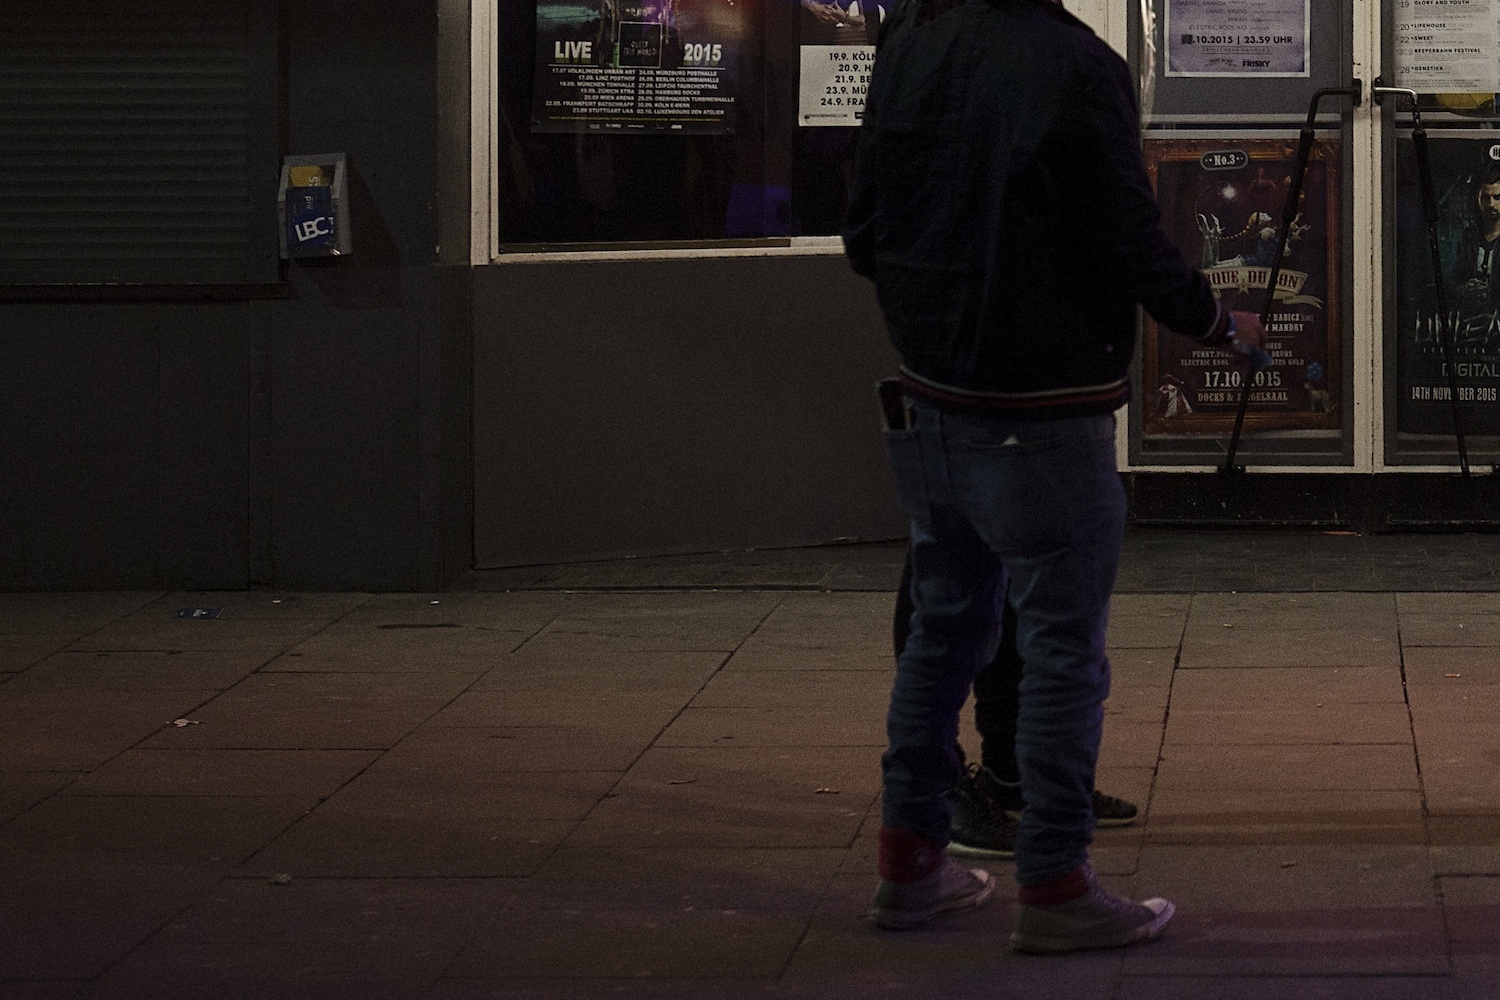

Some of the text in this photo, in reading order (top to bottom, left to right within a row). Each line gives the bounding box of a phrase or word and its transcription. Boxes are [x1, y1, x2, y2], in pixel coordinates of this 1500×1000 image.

[555, 41, 592, 59] LIVE
[684, 44, 722, 61] 2015
[295, 217, 329, 242] LBC
[1248, 271, 1267, 284] DU
[1205, 371, 1281, 387] 17.10.015
[1198, 393, 1224, 401] DOCKS
[1433, 387, 1475, 400] NOVEBER
[1477, 388, 1496, 400] 2015
